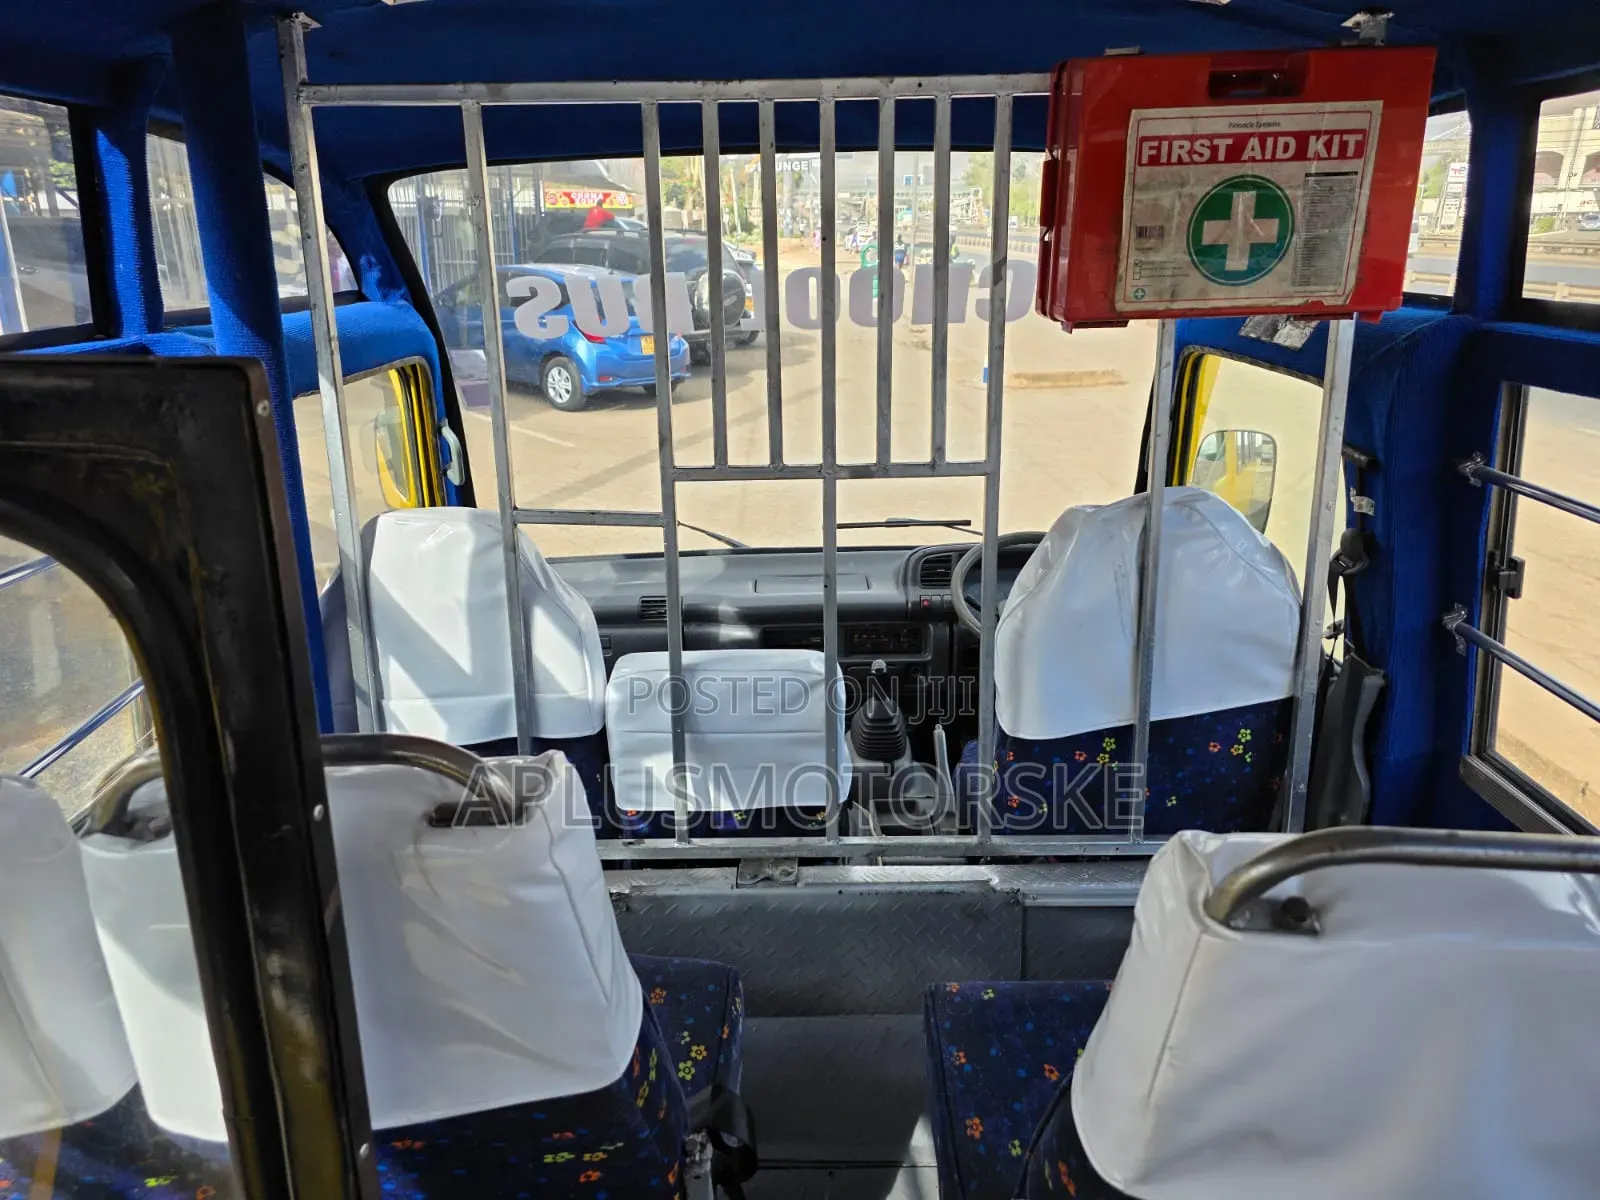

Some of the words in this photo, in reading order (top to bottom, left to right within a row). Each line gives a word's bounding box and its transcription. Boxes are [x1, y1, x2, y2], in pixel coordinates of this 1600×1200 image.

[1141, 138, 1233, 164] FIRST
[1241, 136, 1296, 161] AID
[1307, 133, 1363, 158] KIT
